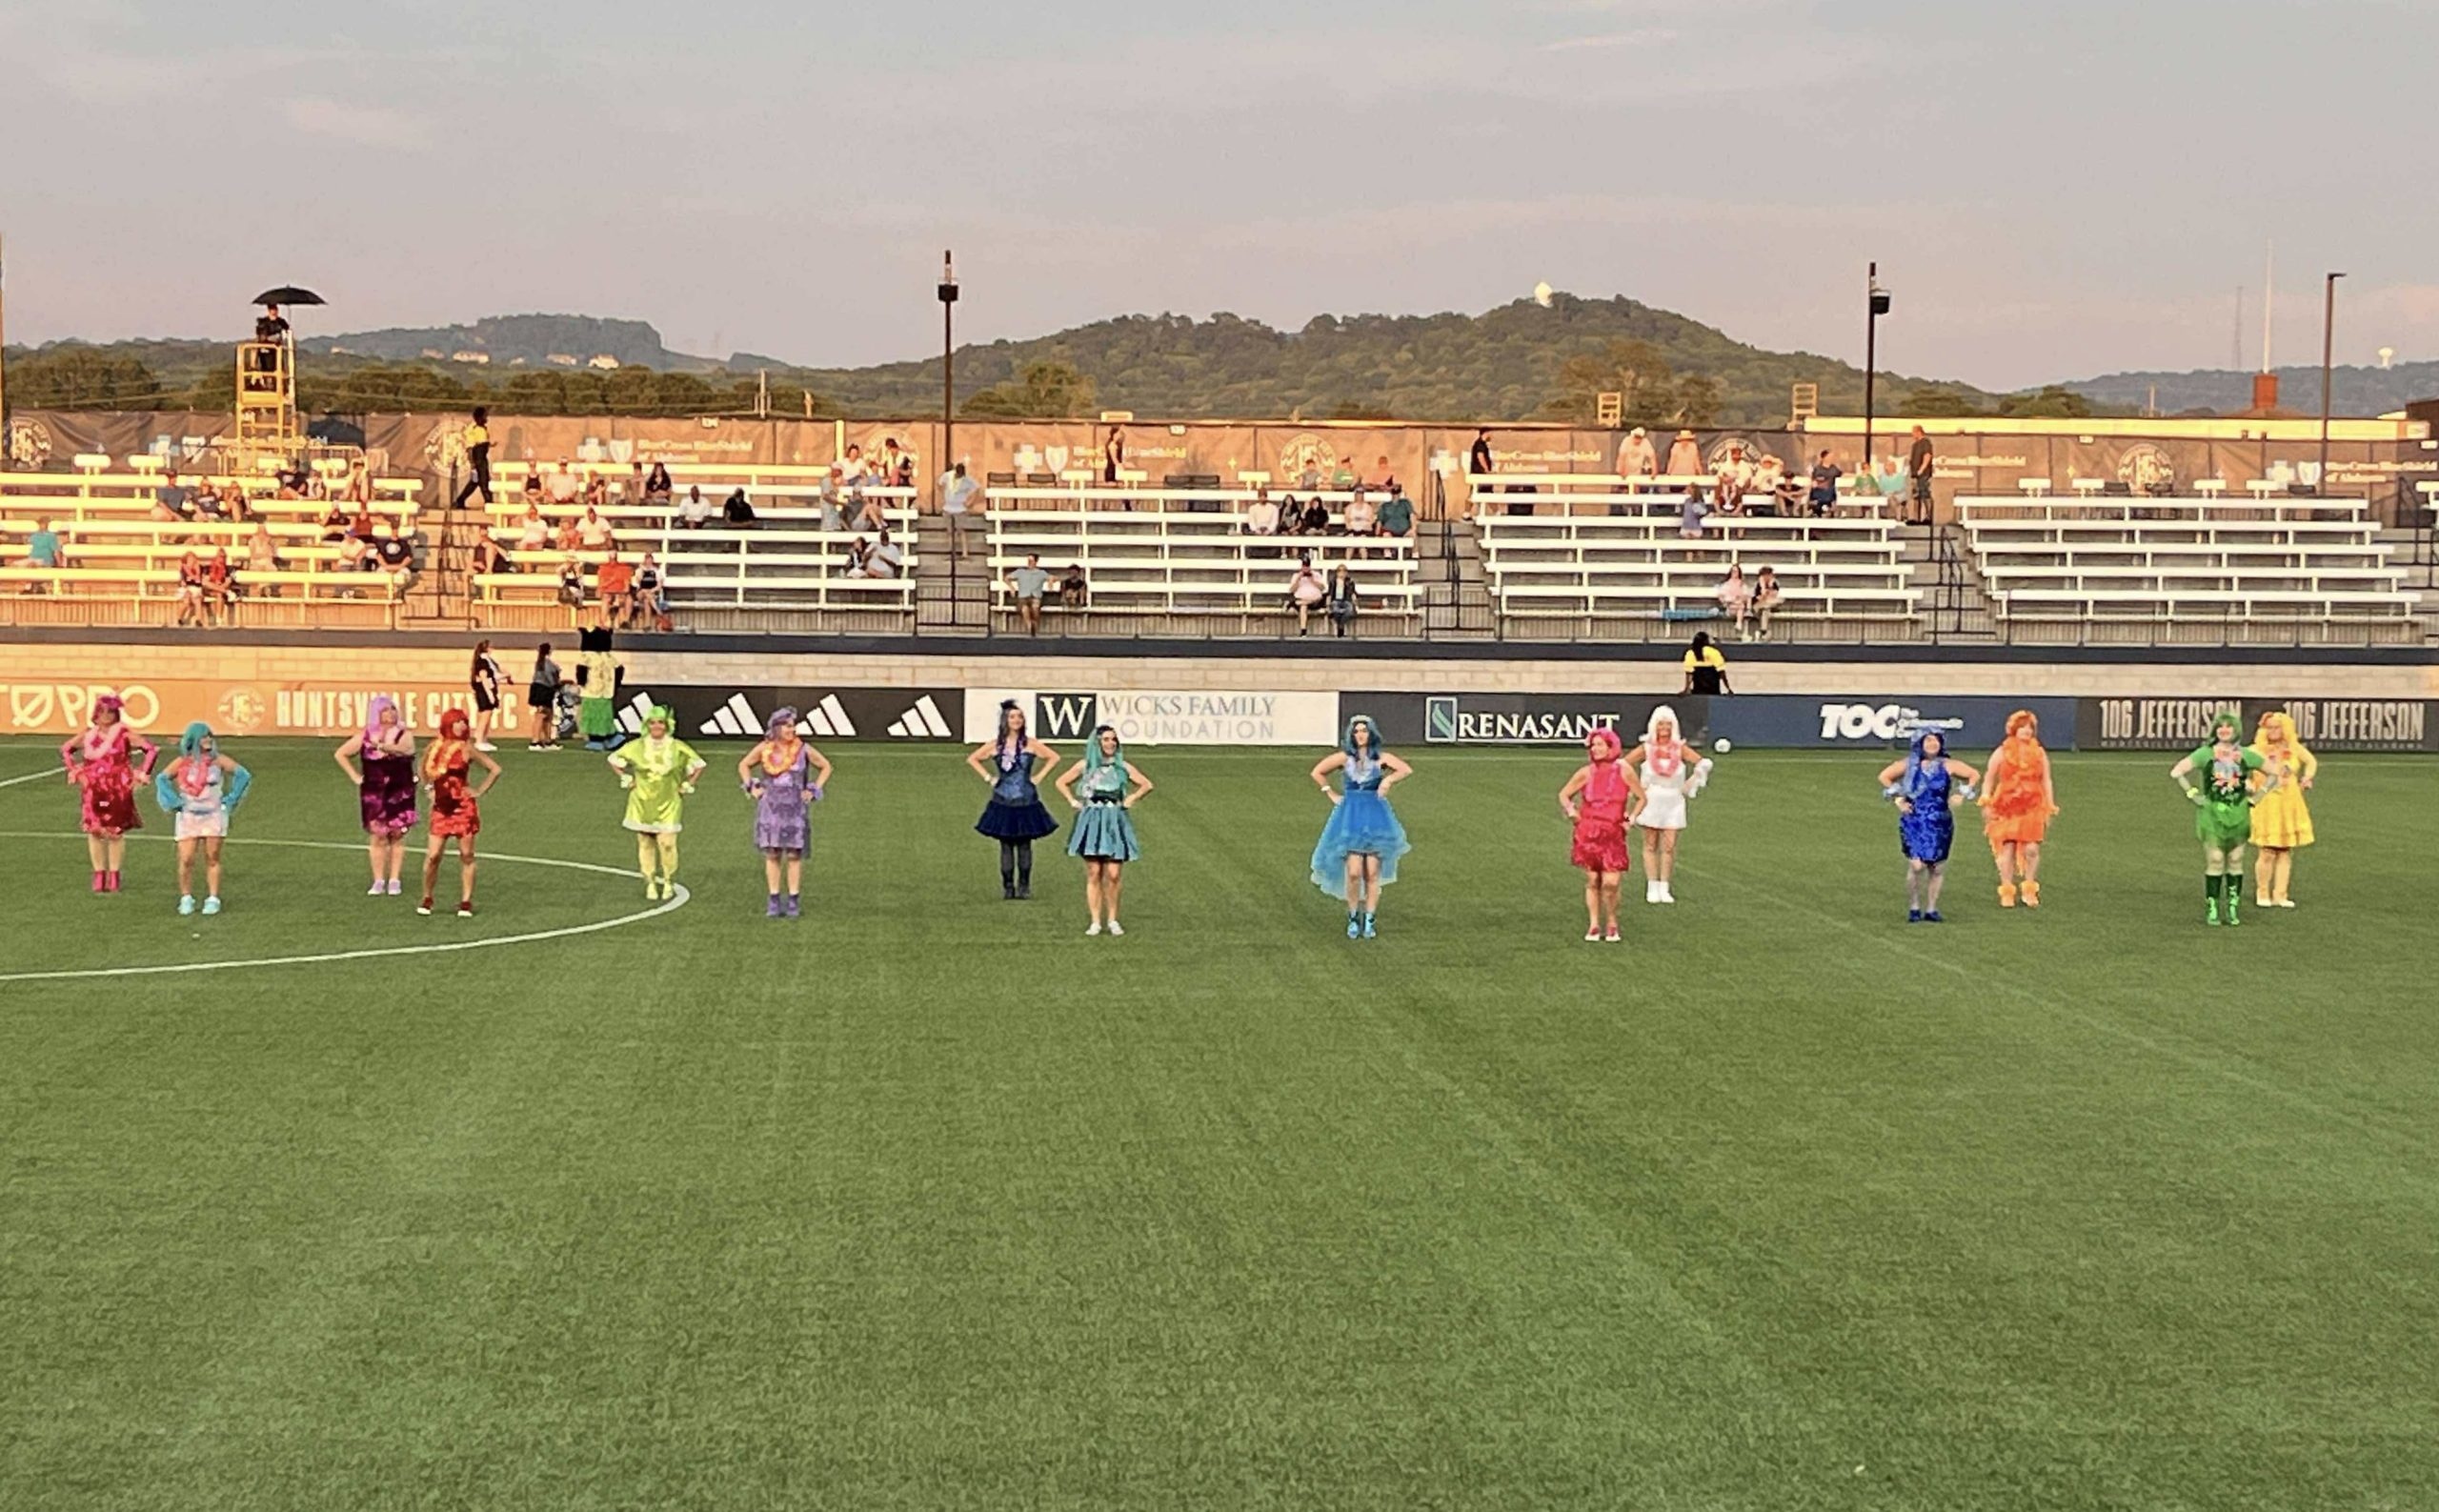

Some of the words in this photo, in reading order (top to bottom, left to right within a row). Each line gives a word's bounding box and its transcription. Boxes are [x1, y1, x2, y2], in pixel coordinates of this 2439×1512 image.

[1039, 696, 1092, 736] W
[1101, 695, 1182, 716] WICKS
[1189, 696, 1276, 716] FAMILY
[1820, 704, 1901, 739] TOC
[2099, 699, 2133, 738] 106
[2319, 701, 2425, 740] JEFFERSON
[1458, 713, 1620, 738] RENASANT
